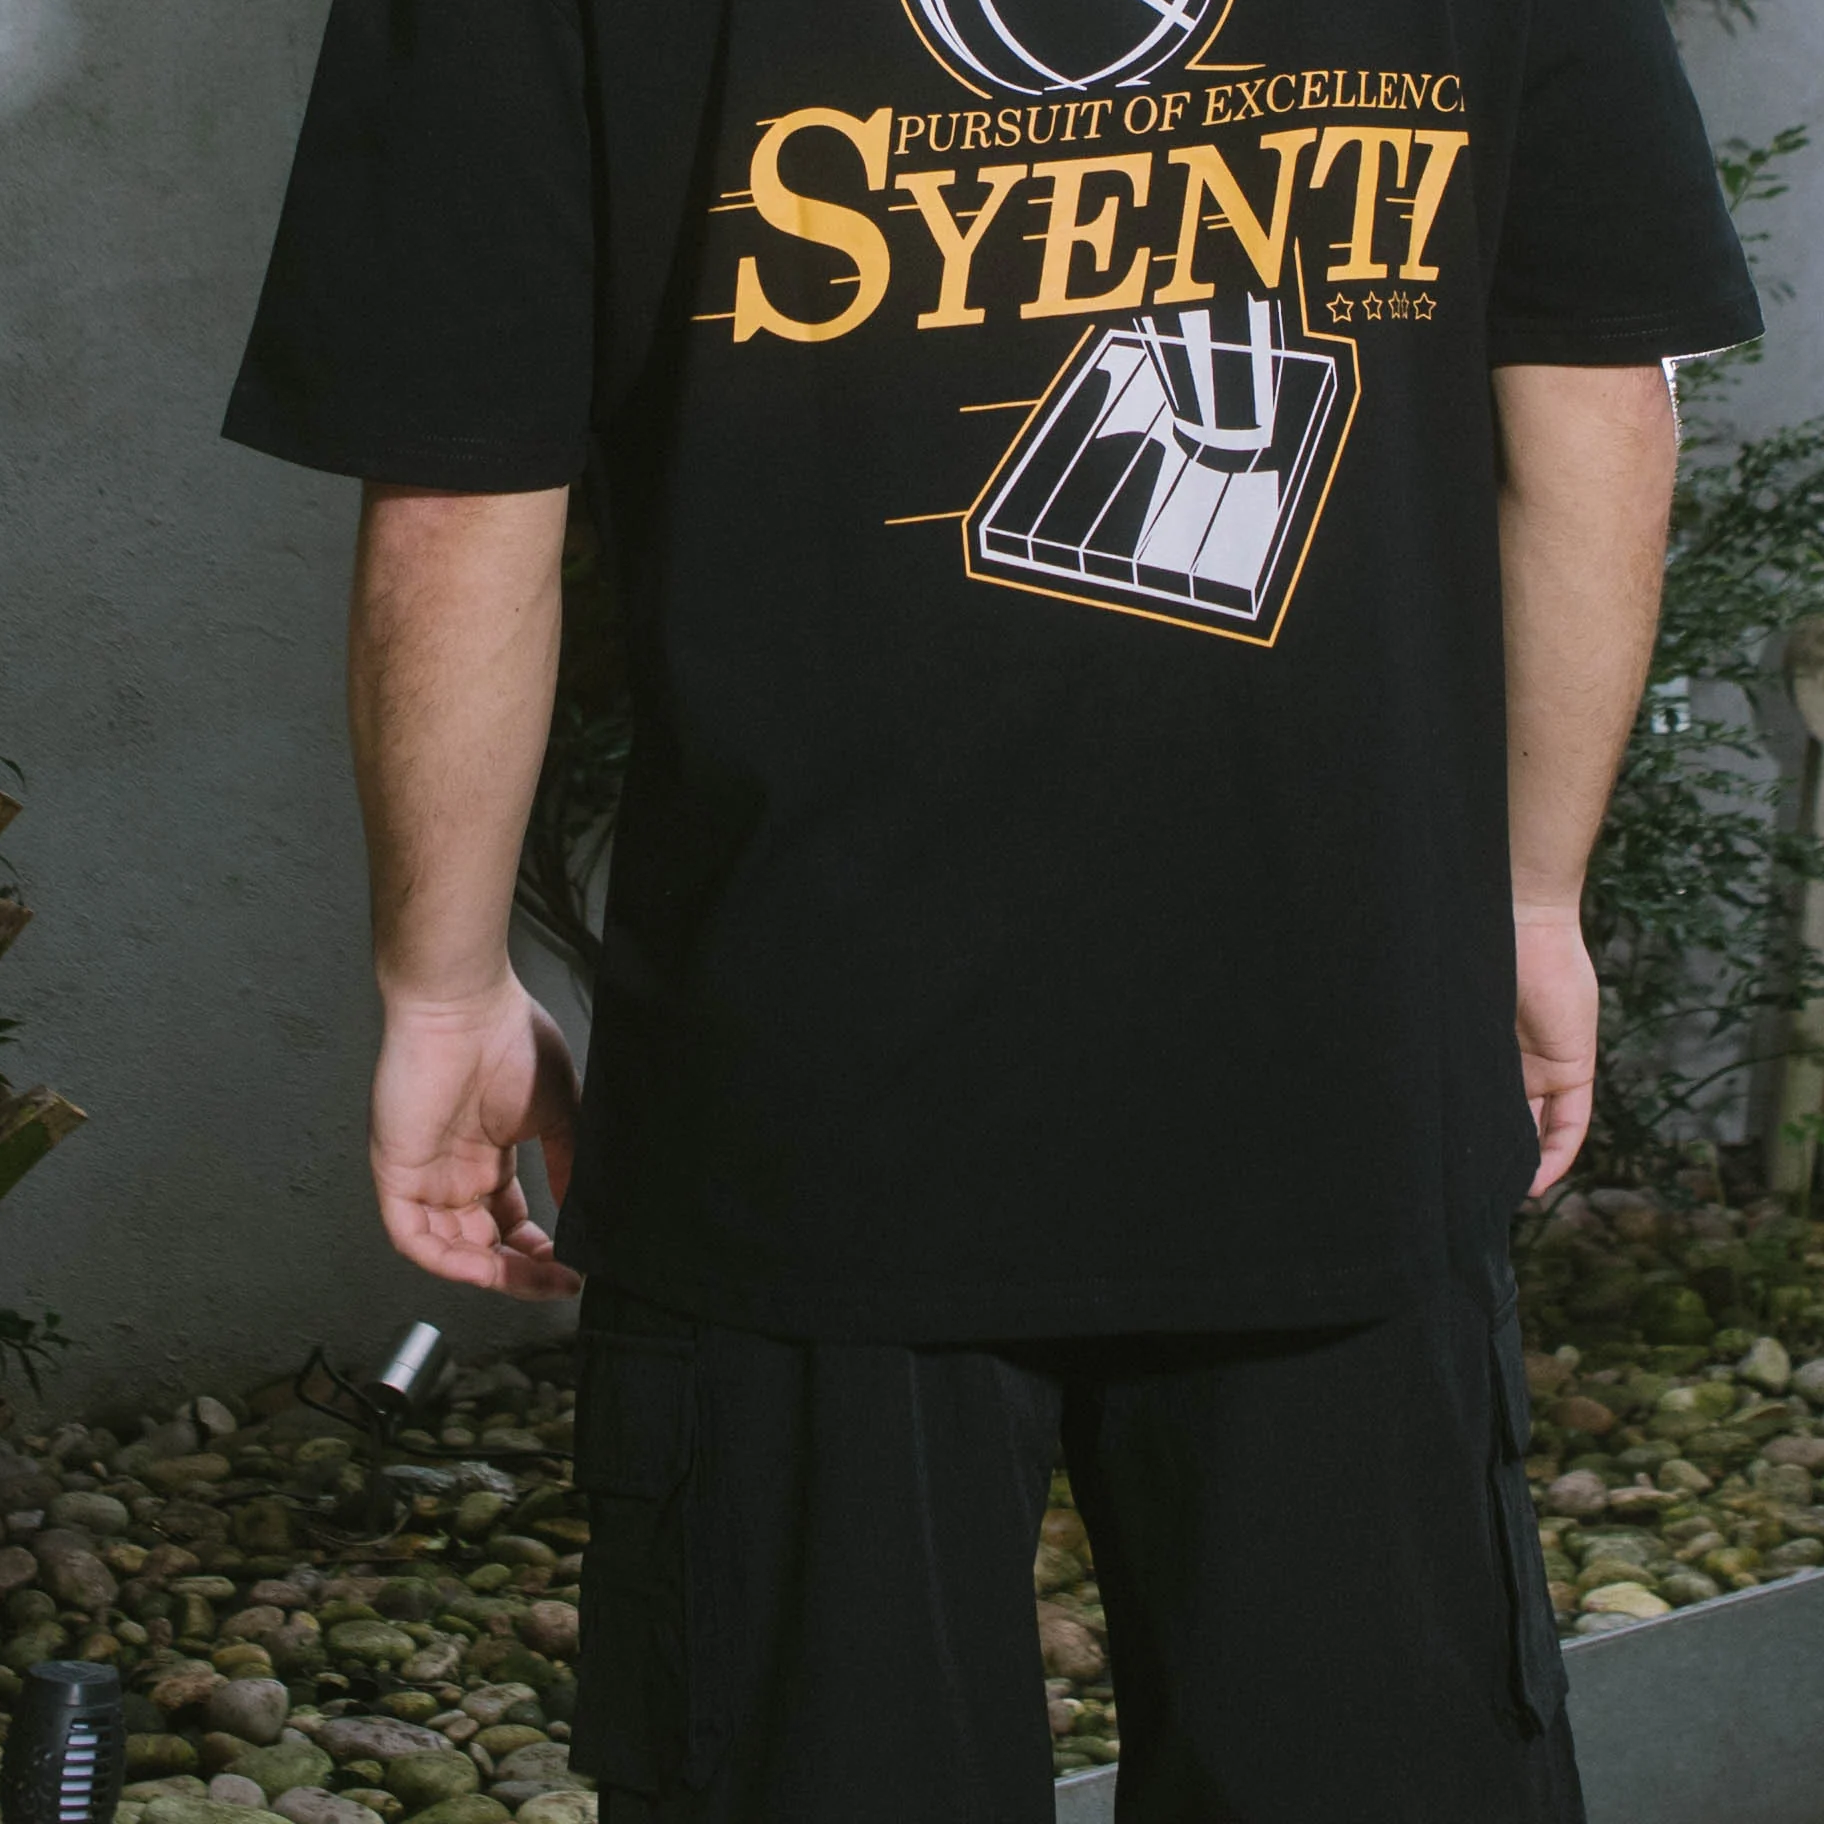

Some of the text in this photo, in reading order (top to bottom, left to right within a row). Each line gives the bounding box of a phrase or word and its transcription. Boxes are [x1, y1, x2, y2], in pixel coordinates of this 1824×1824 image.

[893, 69, 1466, 156] PURSUIT OF EXCELLENC
[732, 106, 1470, 344] SYENTI
